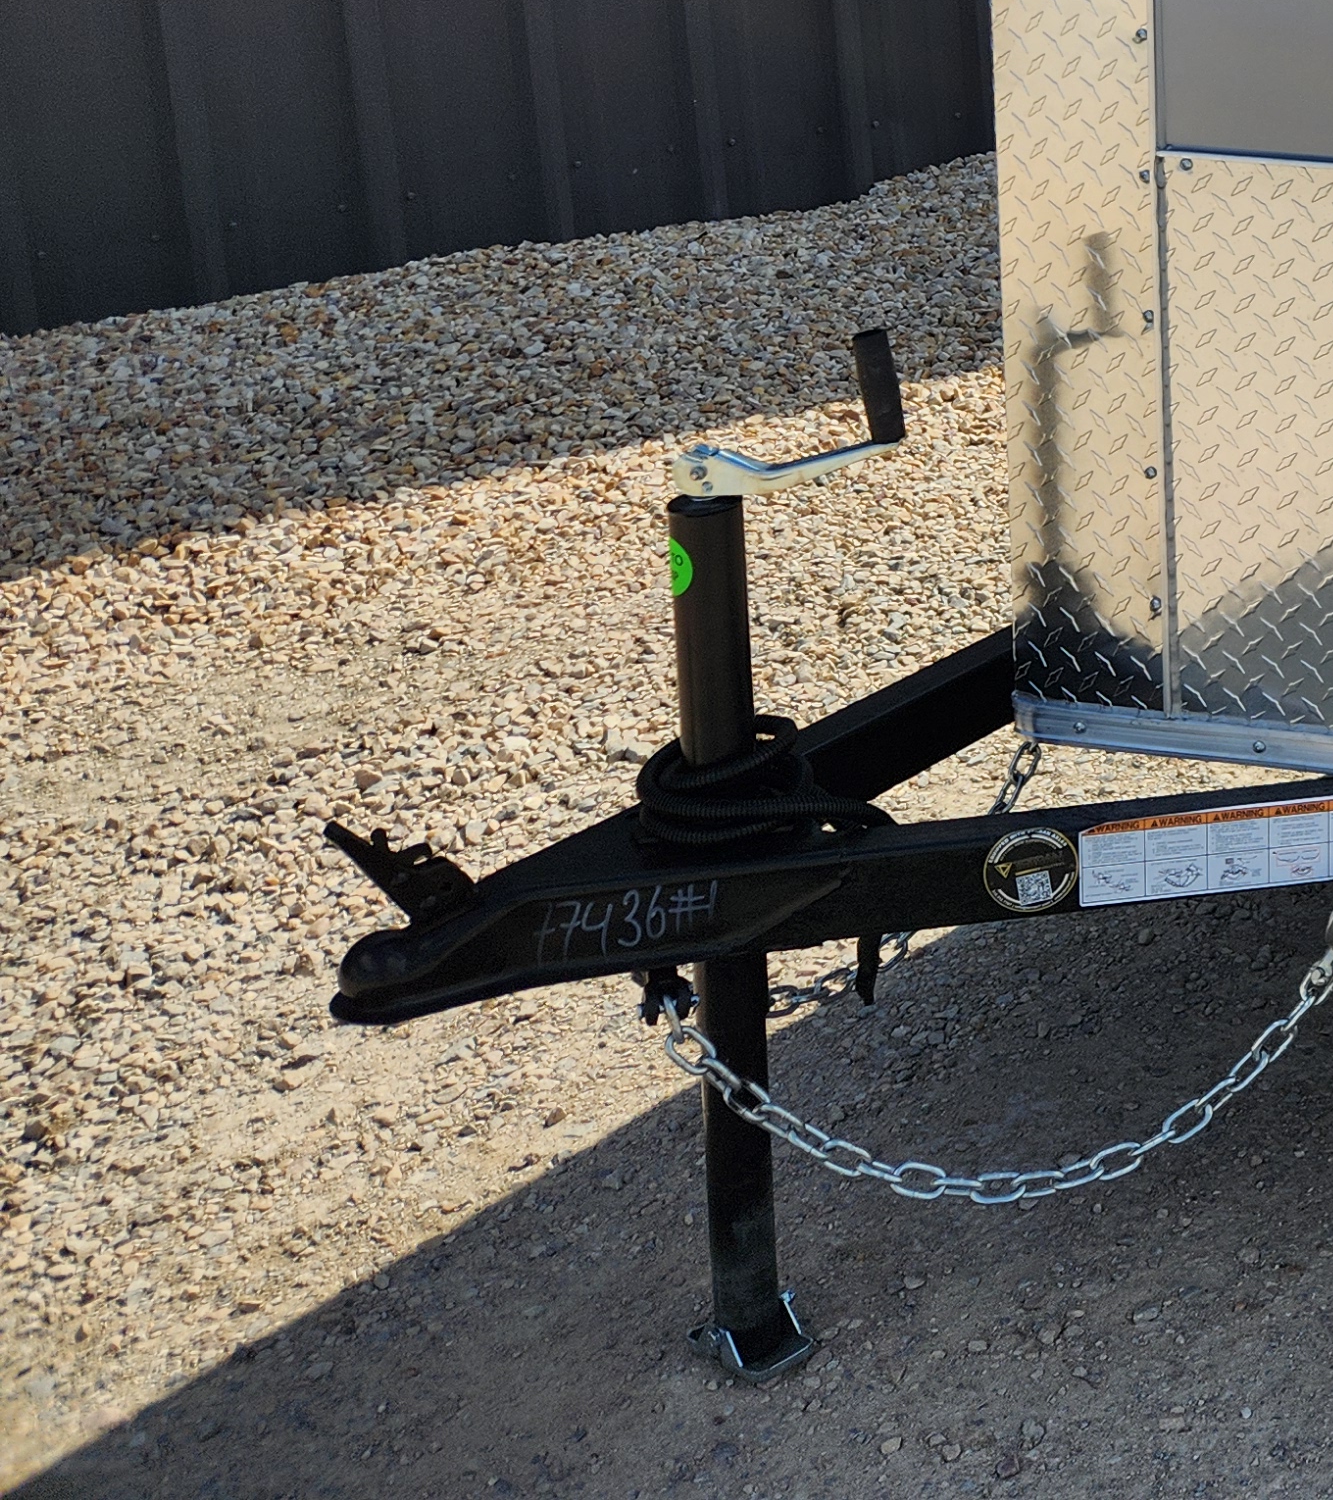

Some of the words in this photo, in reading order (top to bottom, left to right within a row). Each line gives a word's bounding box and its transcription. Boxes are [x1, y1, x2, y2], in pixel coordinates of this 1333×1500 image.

[1221, 808, 1265, 820] WARNING
[1281, 802, 1326, 814] WARNING
[1158, 812, 1202, 827] WARNING
[1094, 820, 1140, 833] WARNING
